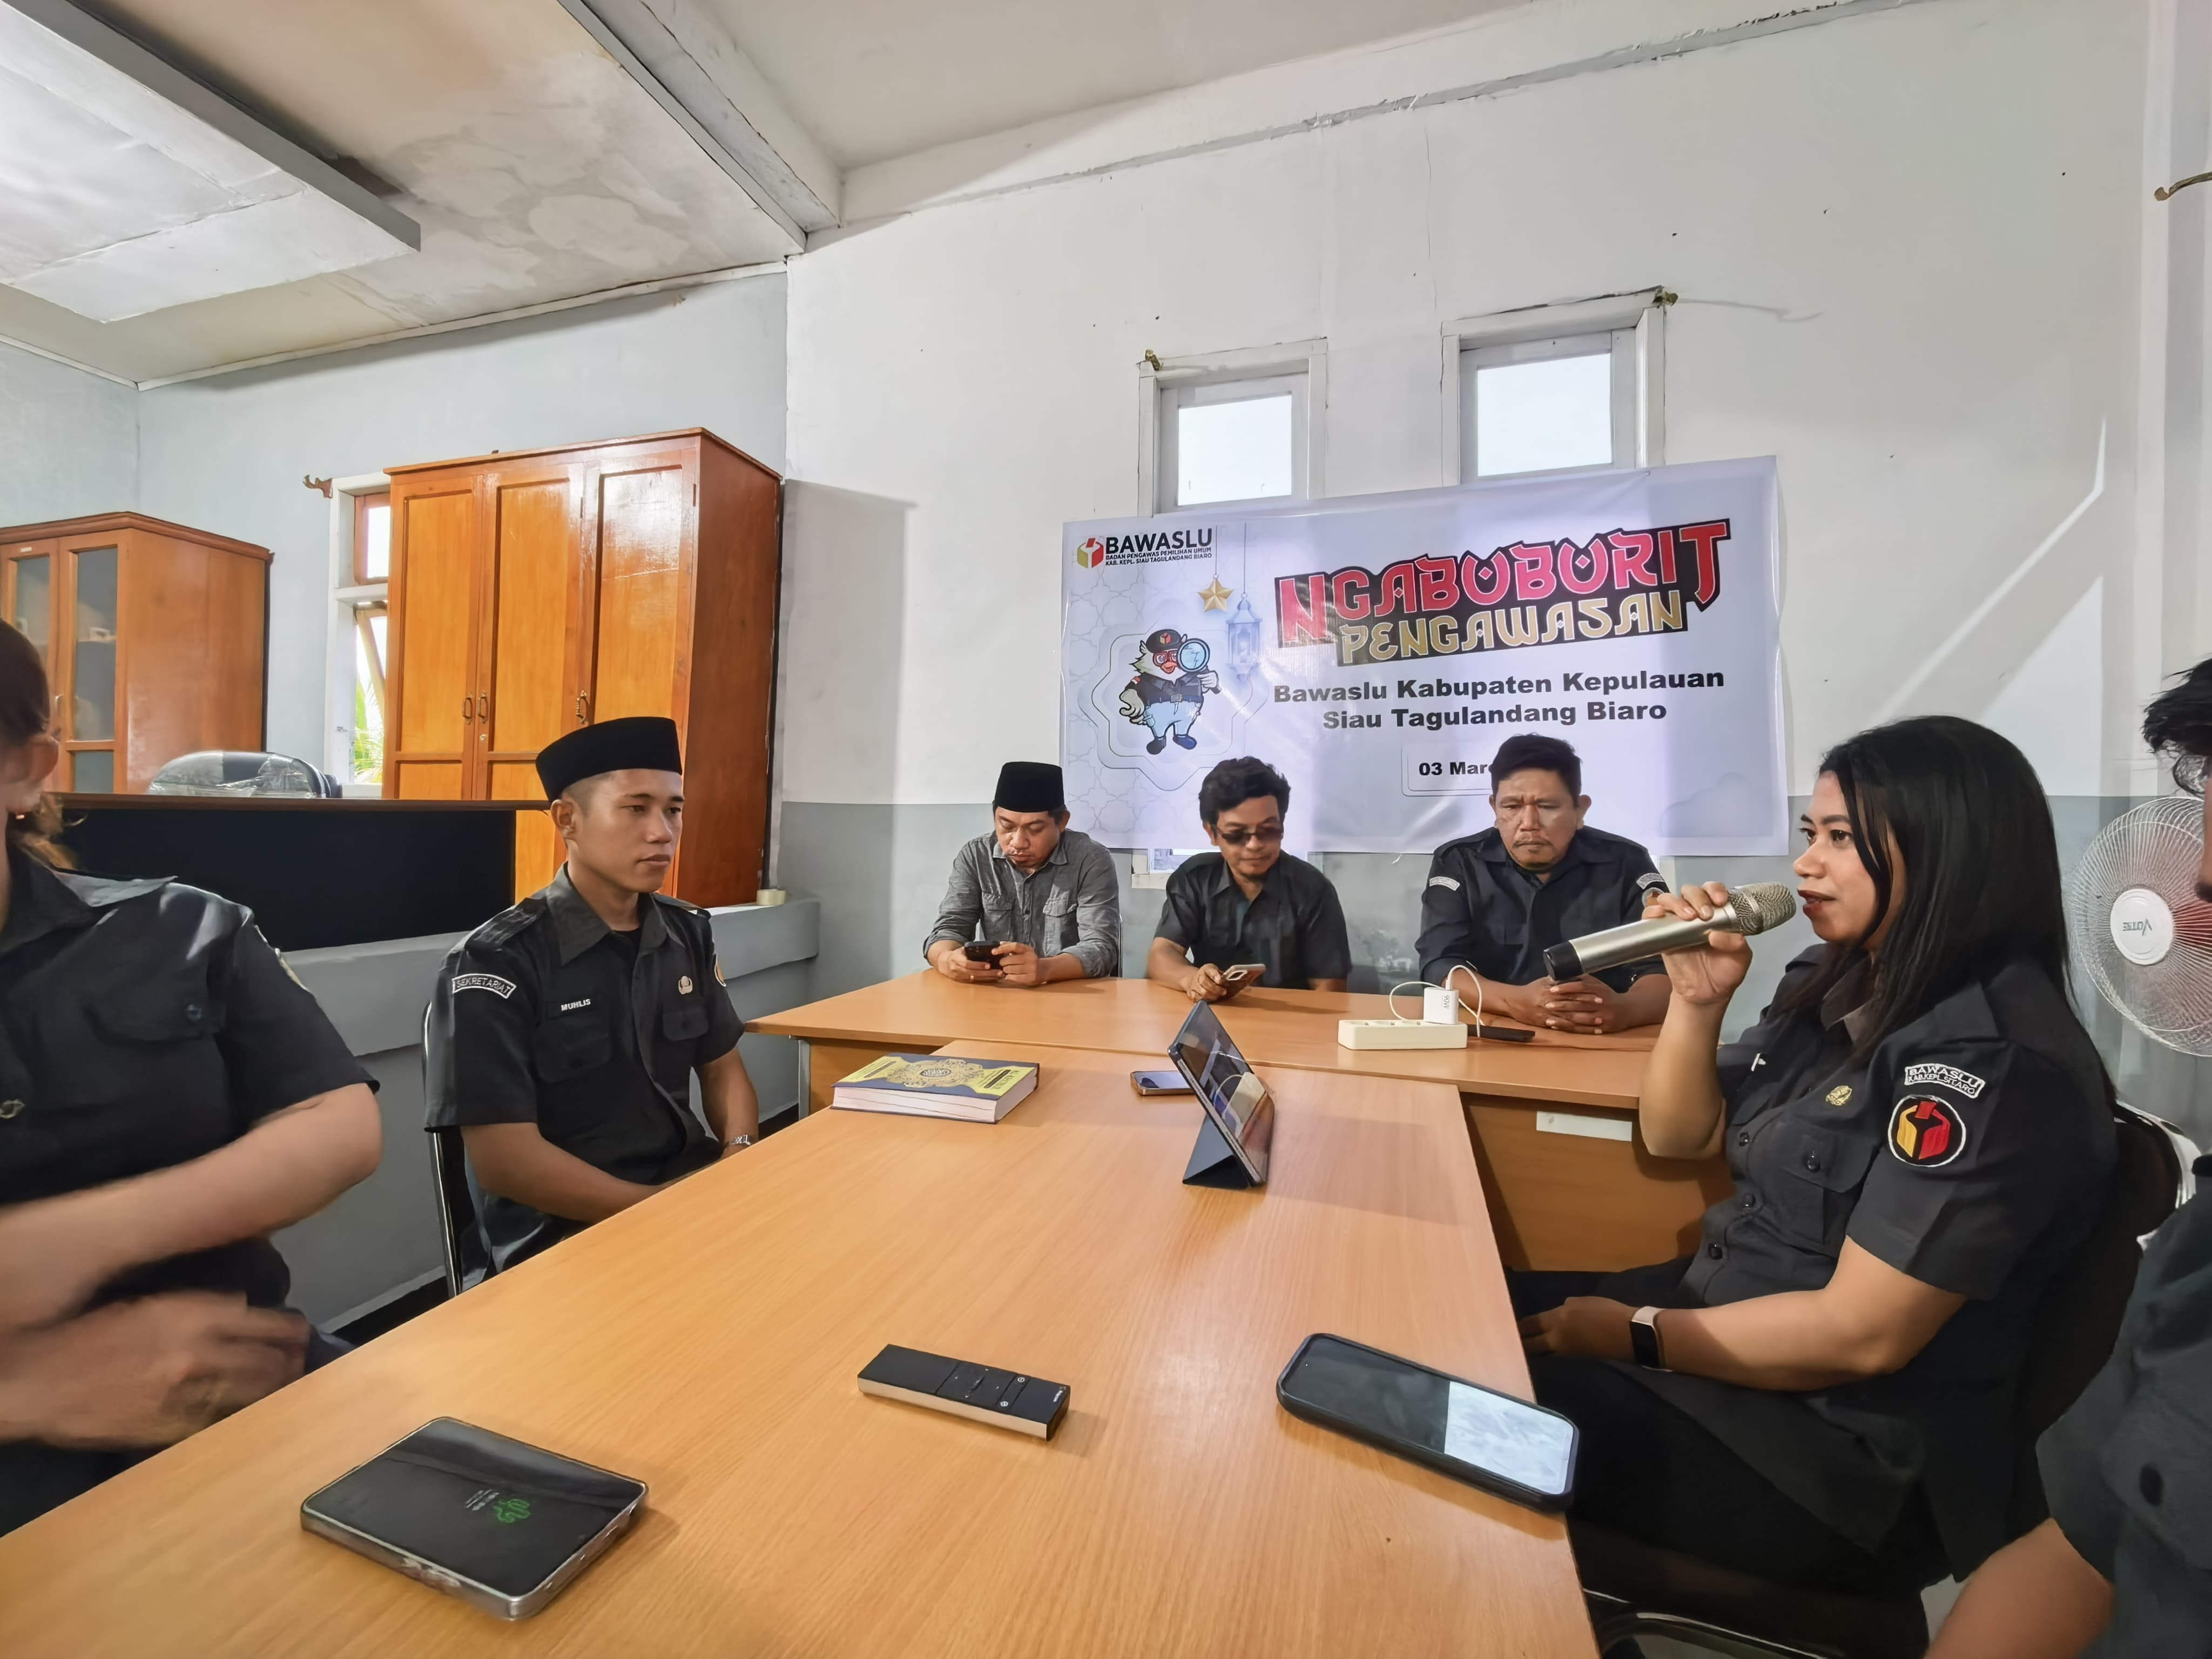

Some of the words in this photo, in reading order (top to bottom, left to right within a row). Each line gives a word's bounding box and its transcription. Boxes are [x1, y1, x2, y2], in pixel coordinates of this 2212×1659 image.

[1105, 528, 1212, 554] BAWASLU
[1150, 554, 1192, 563] TAGULANDANG
[1279, 522, 1728, 643] NGABUBURIT
[1339, 590, 1683, 664] PENGAWASAN
[1274, 682, 1387, 703] Bawaslu
[1397, 676, 1552, 700] Kabupaten
[1563, 671, 1724, 695] Kepulauan
[1323, 711, 1382, 729] Siau
[1391, 704, 1576, 731] Tagulandang
[1587, 701, 1667, 720] Biaro
[1419, 762, 1442, 776] 03
[457, 977, 510, 994] SEKRETARIAT
[561, 999, 591, 1011] MUHLIS
[1910, 1066, 1980, 1088] BAWASLU
[1944, 1076, 1975, 1094] SITARO
